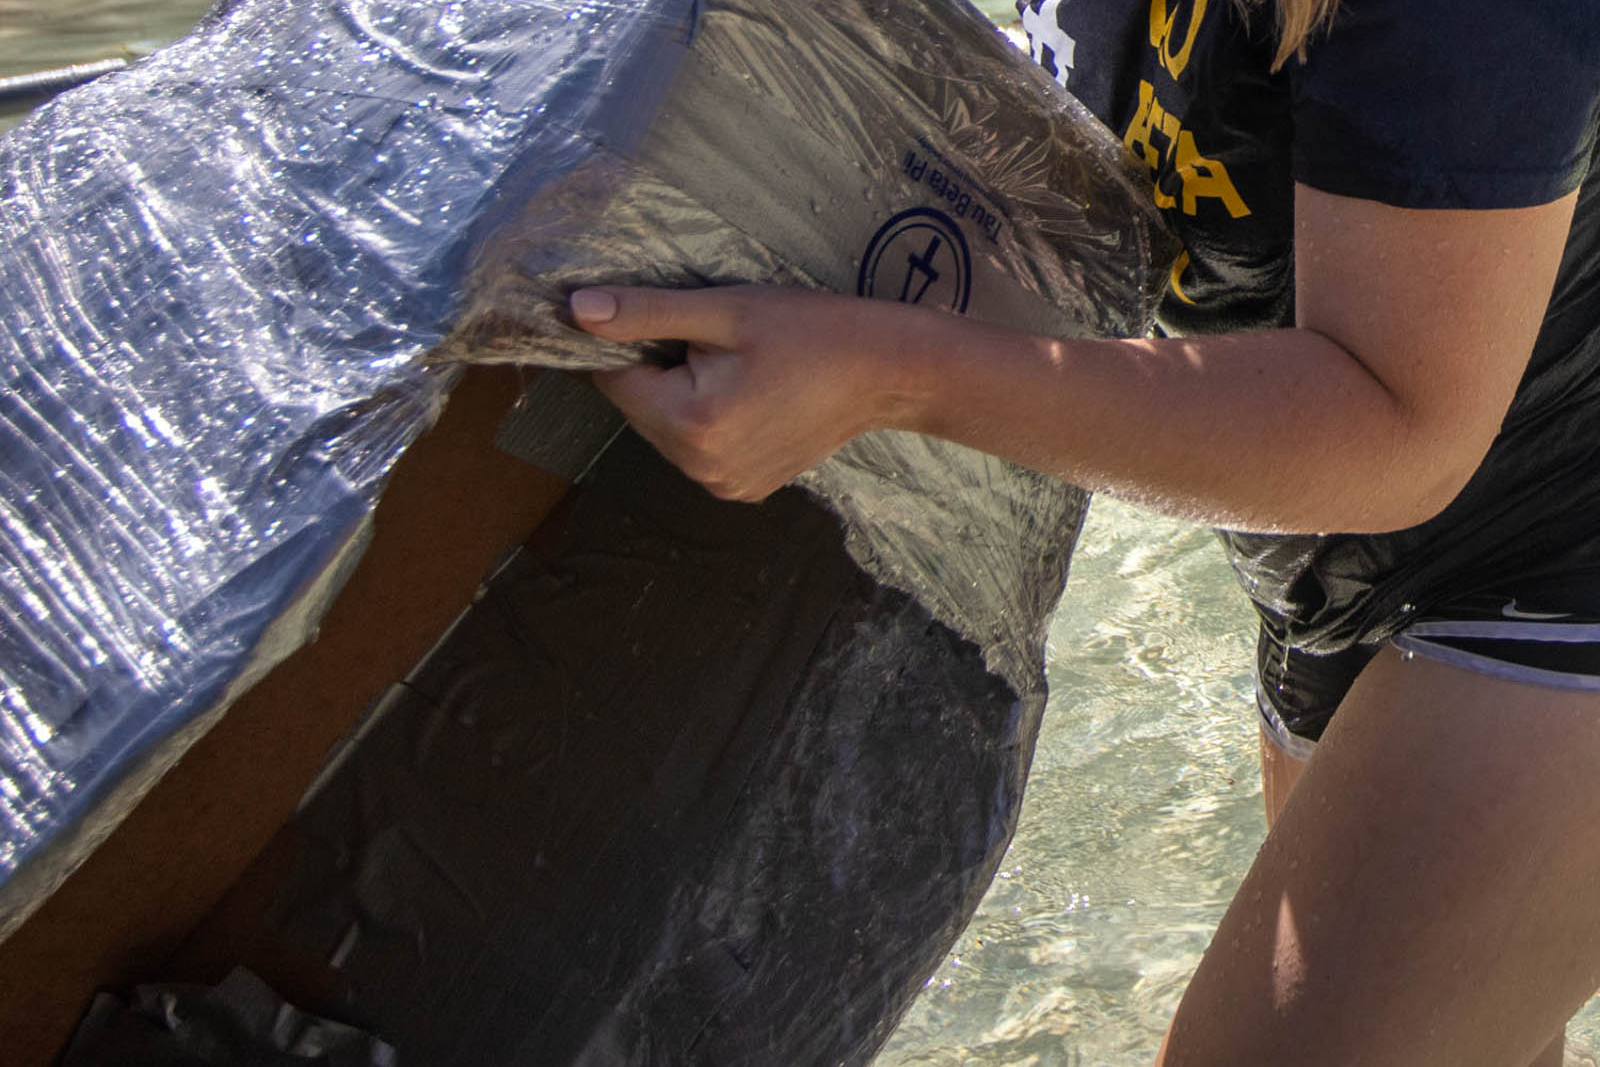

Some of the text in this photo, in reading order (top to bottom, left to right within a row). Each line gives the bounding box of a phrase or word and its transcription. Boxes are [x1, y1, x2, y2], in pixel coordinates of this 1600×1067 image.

[903, 150, 928, 183] Pi
[928, 168, 973, 218] Beta
[970, 204, 1003, 246] Tau
